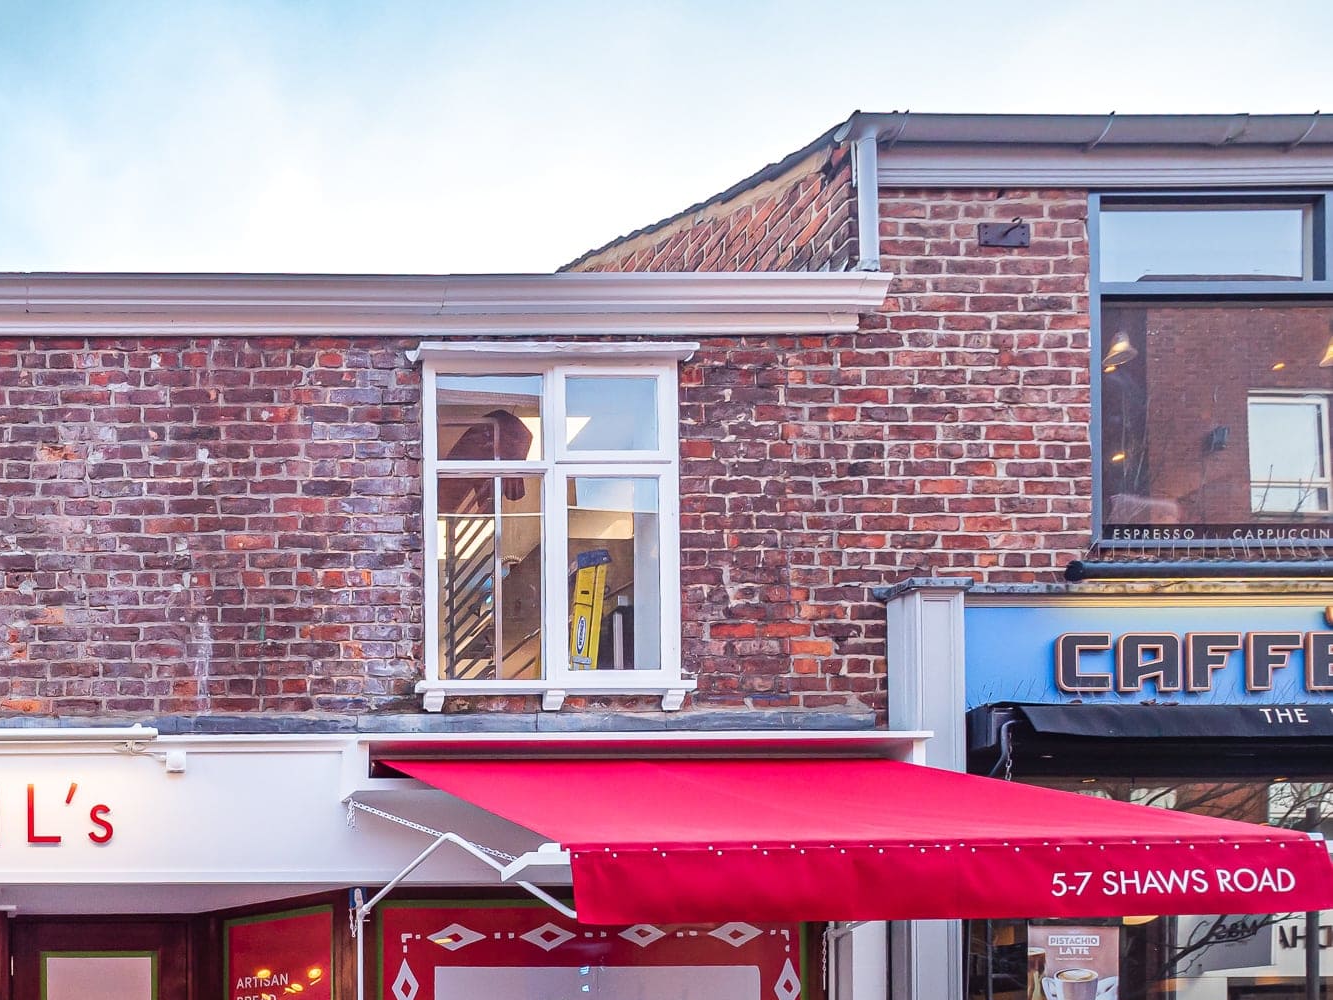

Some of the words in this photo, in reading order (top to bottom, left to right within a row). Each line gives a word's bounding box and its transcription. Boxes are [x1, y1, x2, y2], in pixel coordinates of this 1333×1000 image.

[1113, 528, 1194, 540] ESPRESSO
[1259, 708, 1309, 724] THE
[1051, 872, 1093, 897] 5-7
[1102, 869, 1209, 896] SHAWS
[1216, 868, 1296, 893] ROAD
[1049, 937, 1098, 945] PISTACHIO
[1059, 946, 1091, 955] LATTE
[236, 973, 288, 990] ARTISAN
